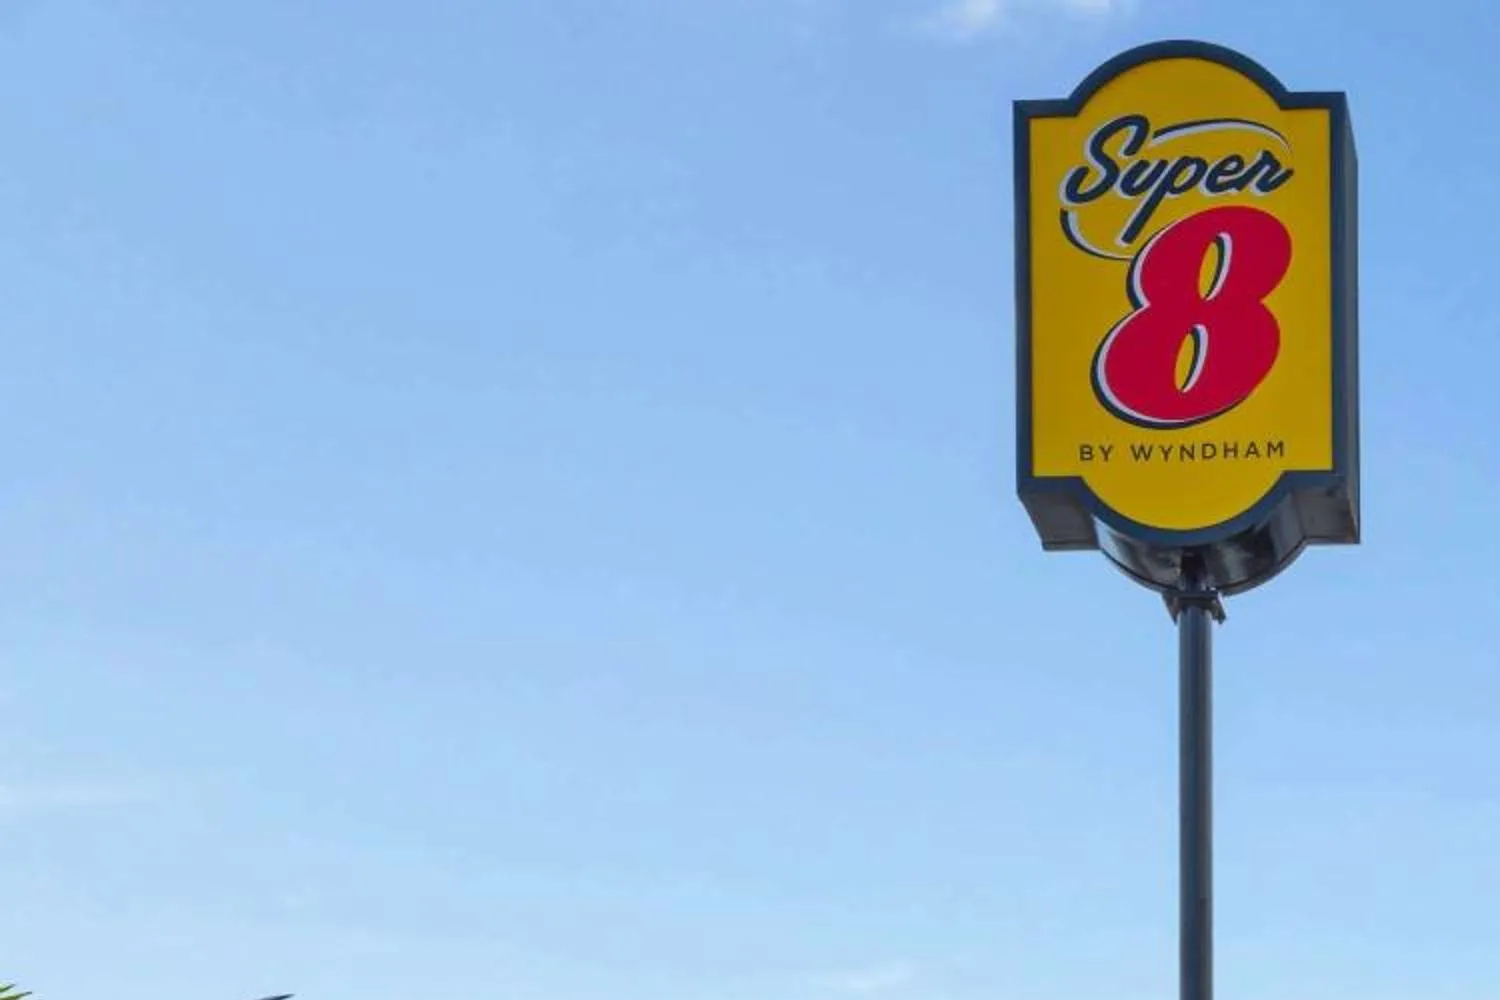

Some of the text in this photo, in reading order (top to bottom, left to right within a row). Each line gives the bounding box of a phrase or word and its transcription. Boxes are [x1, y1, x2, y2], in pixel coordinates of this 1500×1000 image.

[1060, 113, 1294, 245] Super
[1090, 205, 1292, 430] 8
[1079, 441, 1286, 463] BY WYNDHAM
